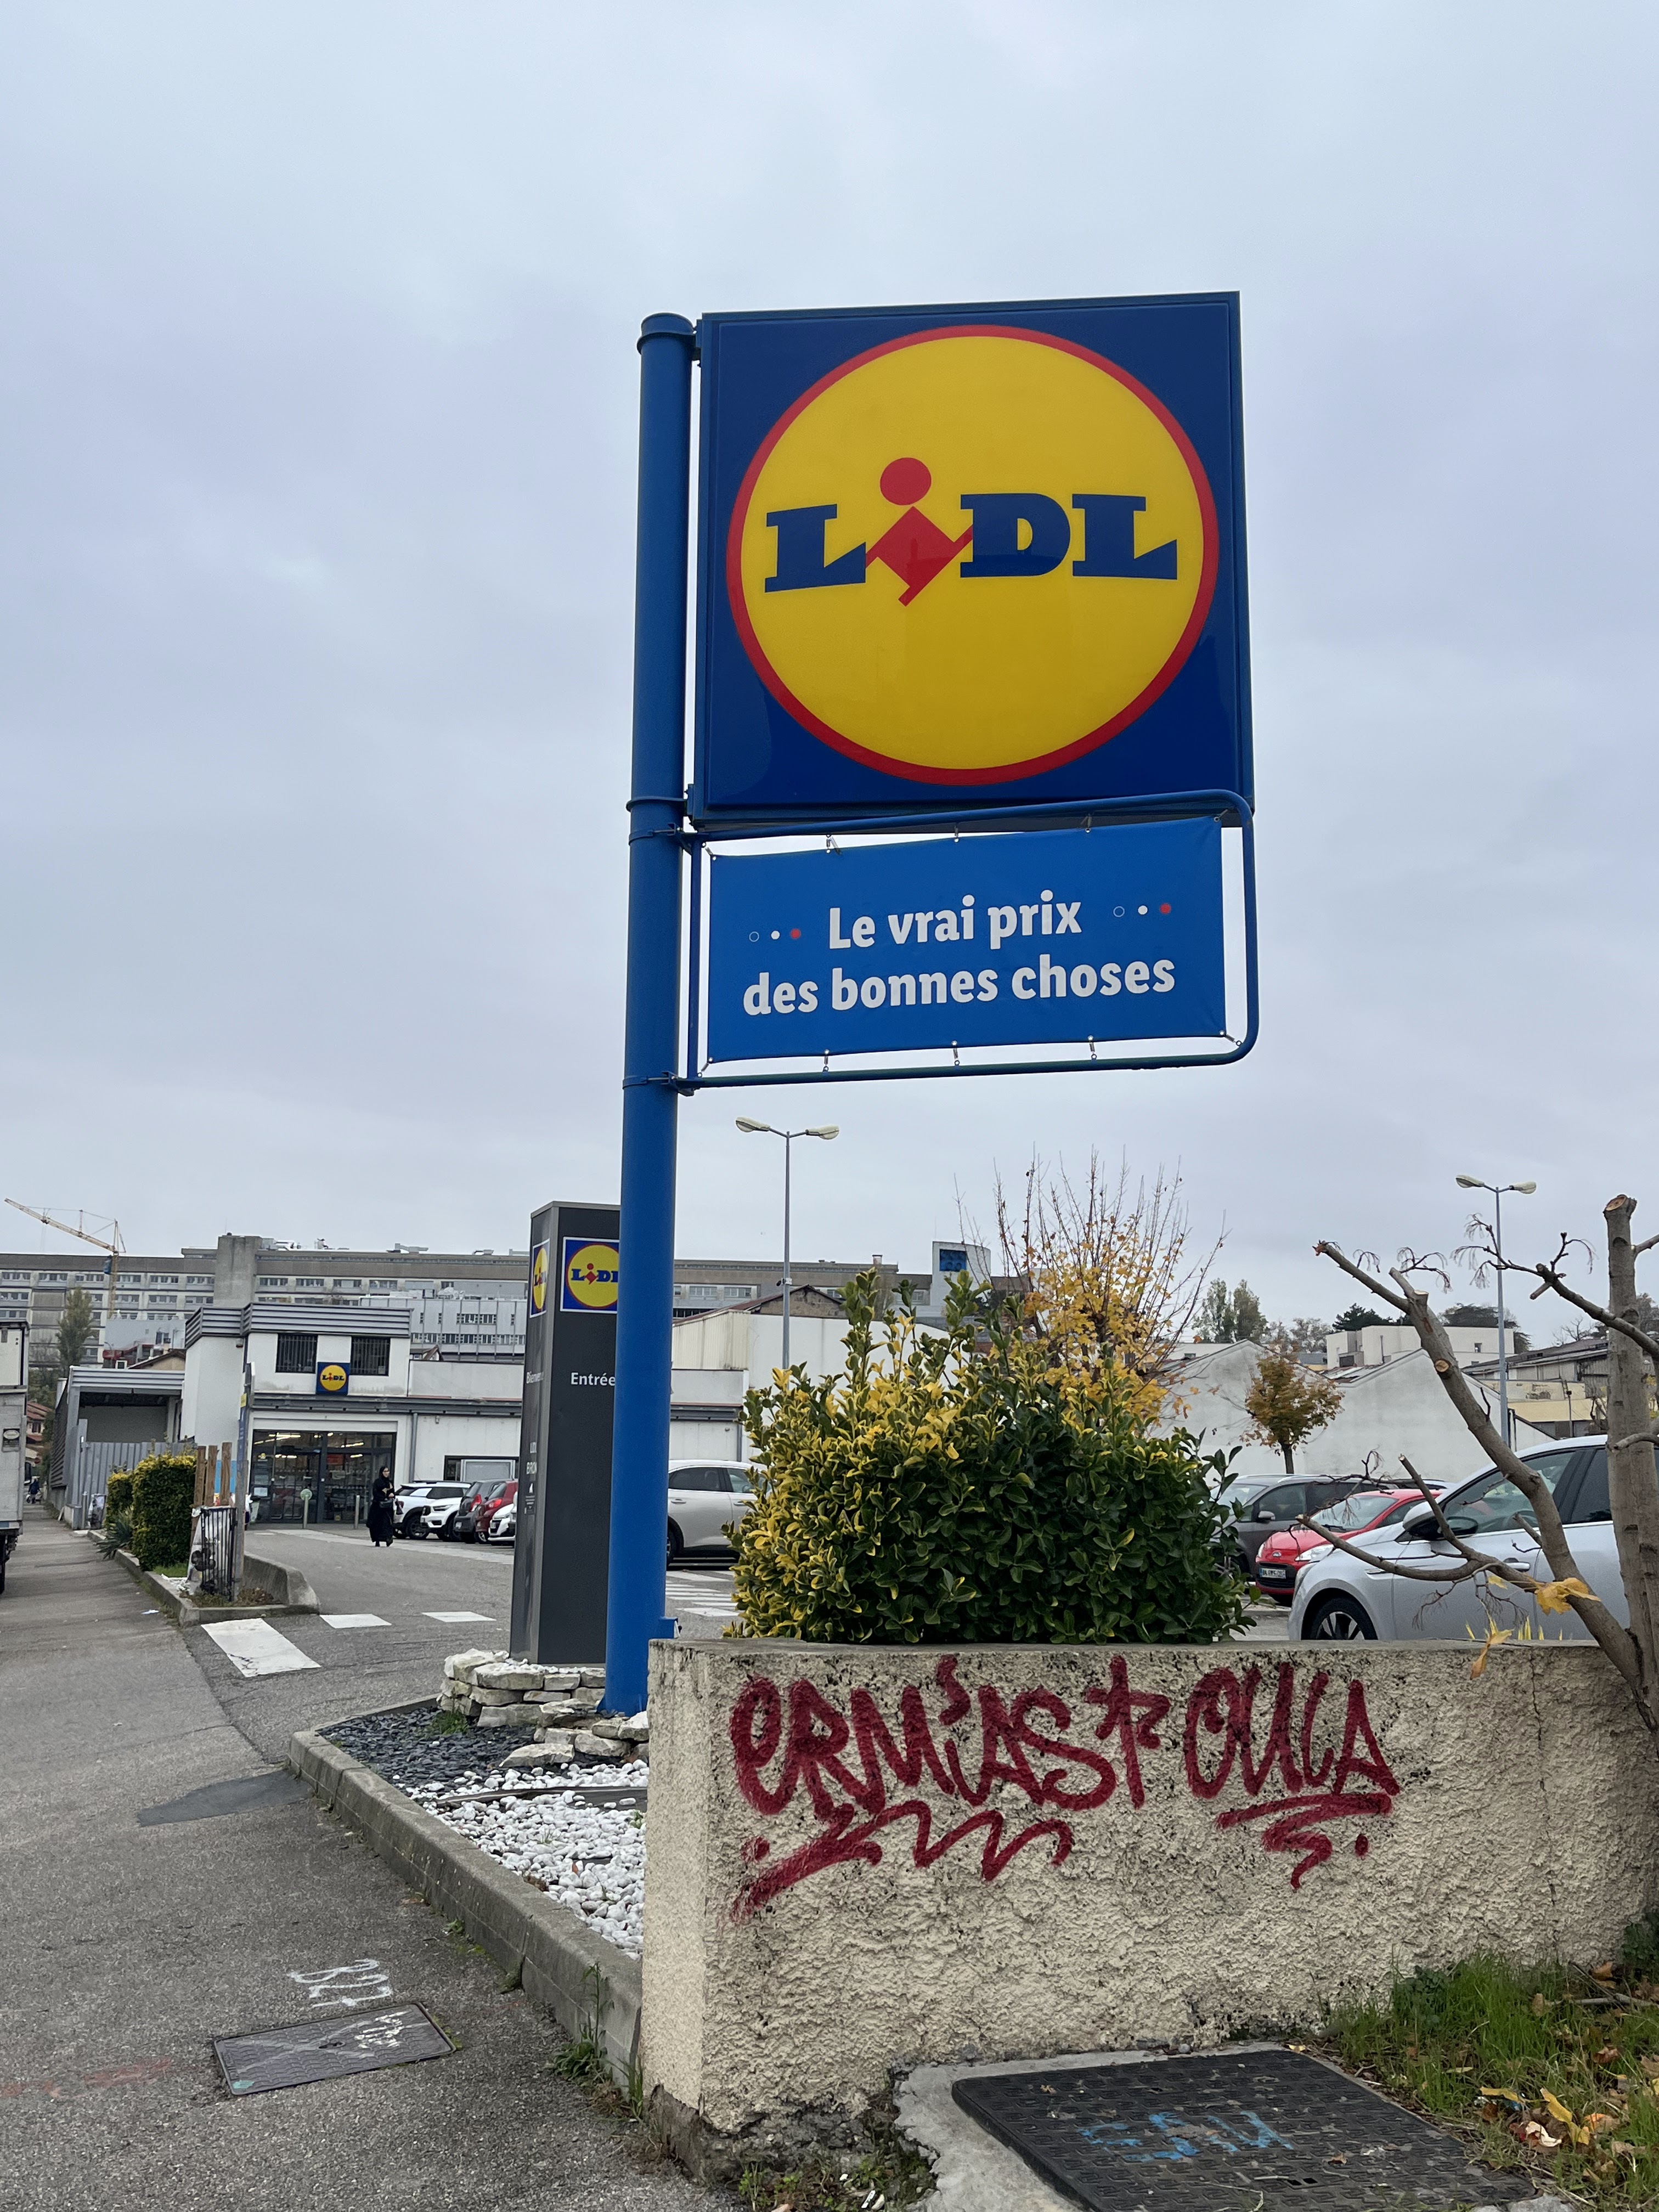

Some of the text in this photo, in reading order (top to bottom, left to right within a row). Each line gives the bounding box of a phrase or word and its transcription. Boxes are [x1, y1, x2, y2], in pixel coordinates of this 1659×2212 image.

[764, 457, 1178, 607] LIDL
[829, 889, 1082, 950] Le vrai prix
[743, 953, 1175, 1016] des bonnes choses
[321, 1373, 345, 1381] LIDL
[571, 1372, 616, 1386] Entrée
